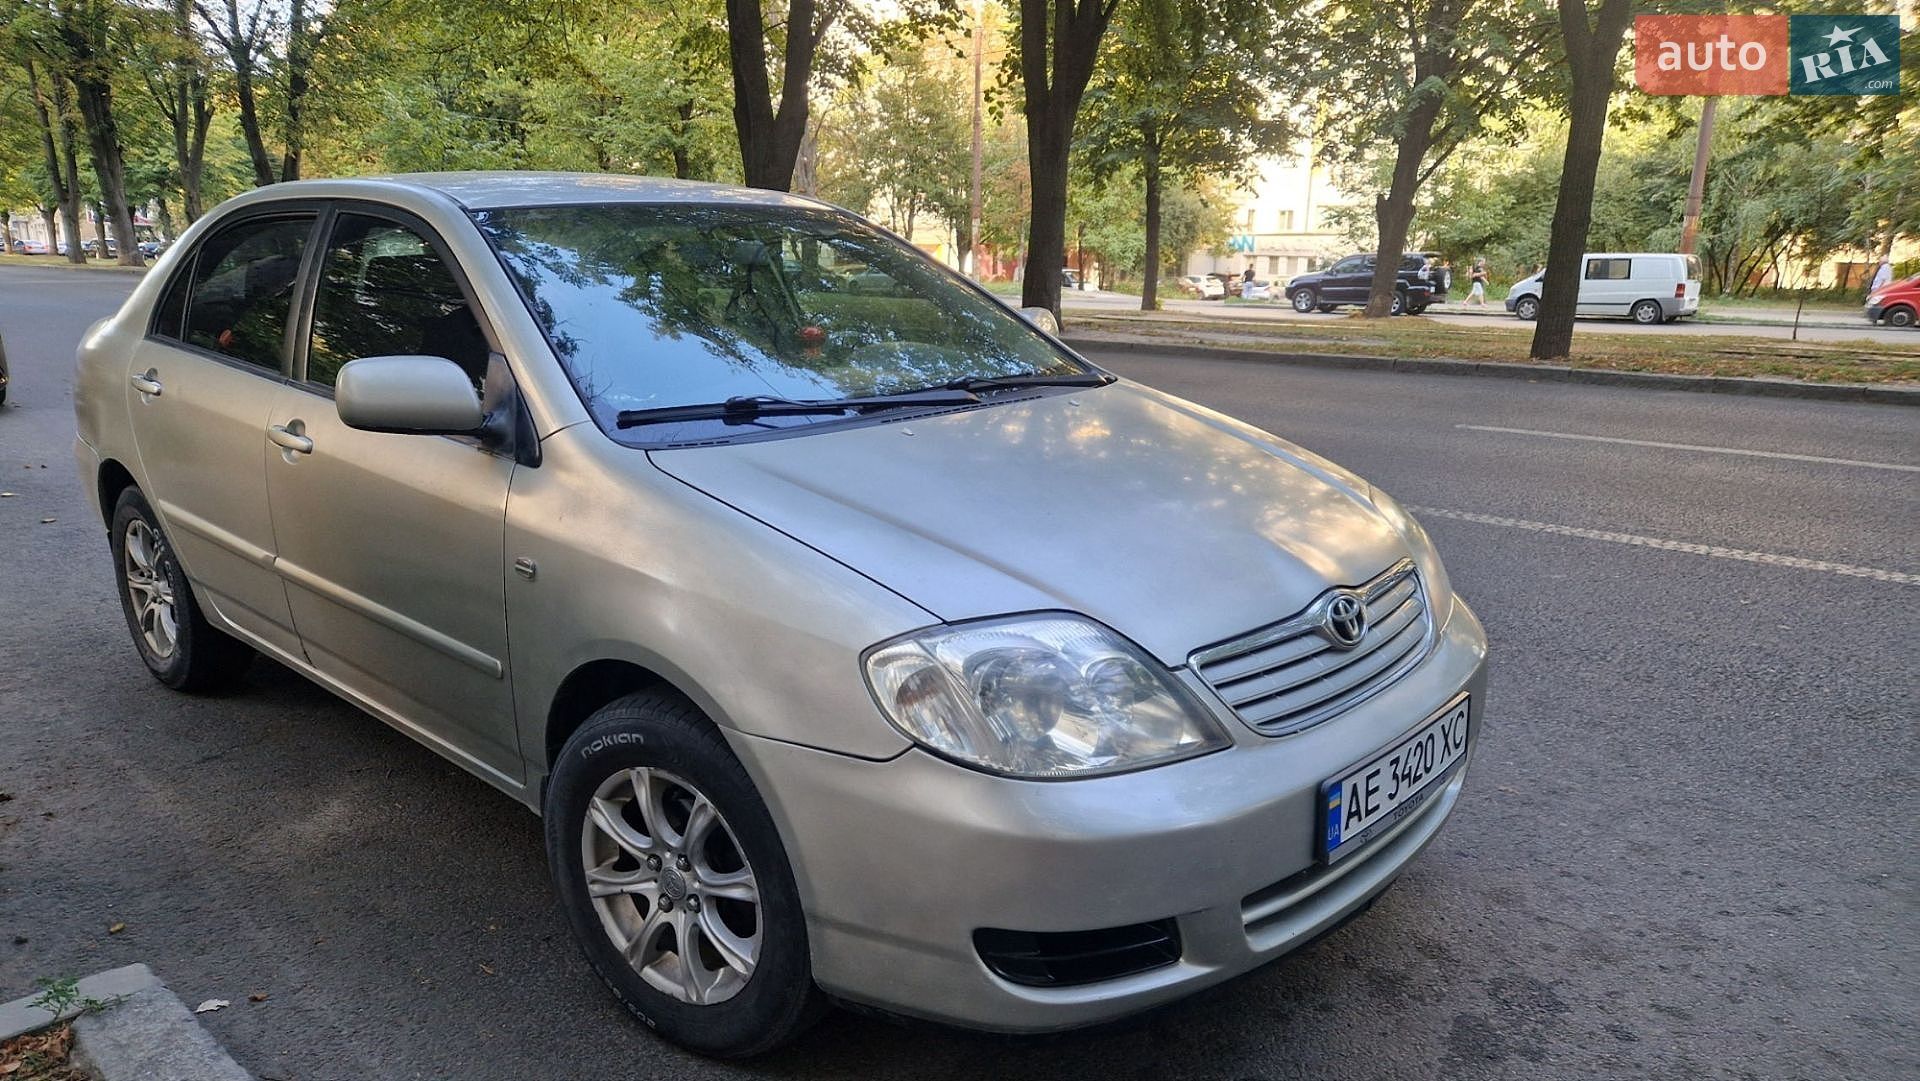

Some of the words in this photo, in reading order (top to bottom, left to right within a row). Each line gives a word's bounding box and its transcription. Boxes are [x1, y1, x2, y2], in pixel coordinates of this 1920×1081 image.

[581, 733, 645, 759] nokian
[1344, 768, 1381, 831] AE
[1388, 732, 1435, 801] 3420
[1440, 710, 1465, 765] XC
[1393, 792, 1425, 821] TOYOTA
[1327, 824, 1340, 841] UA
